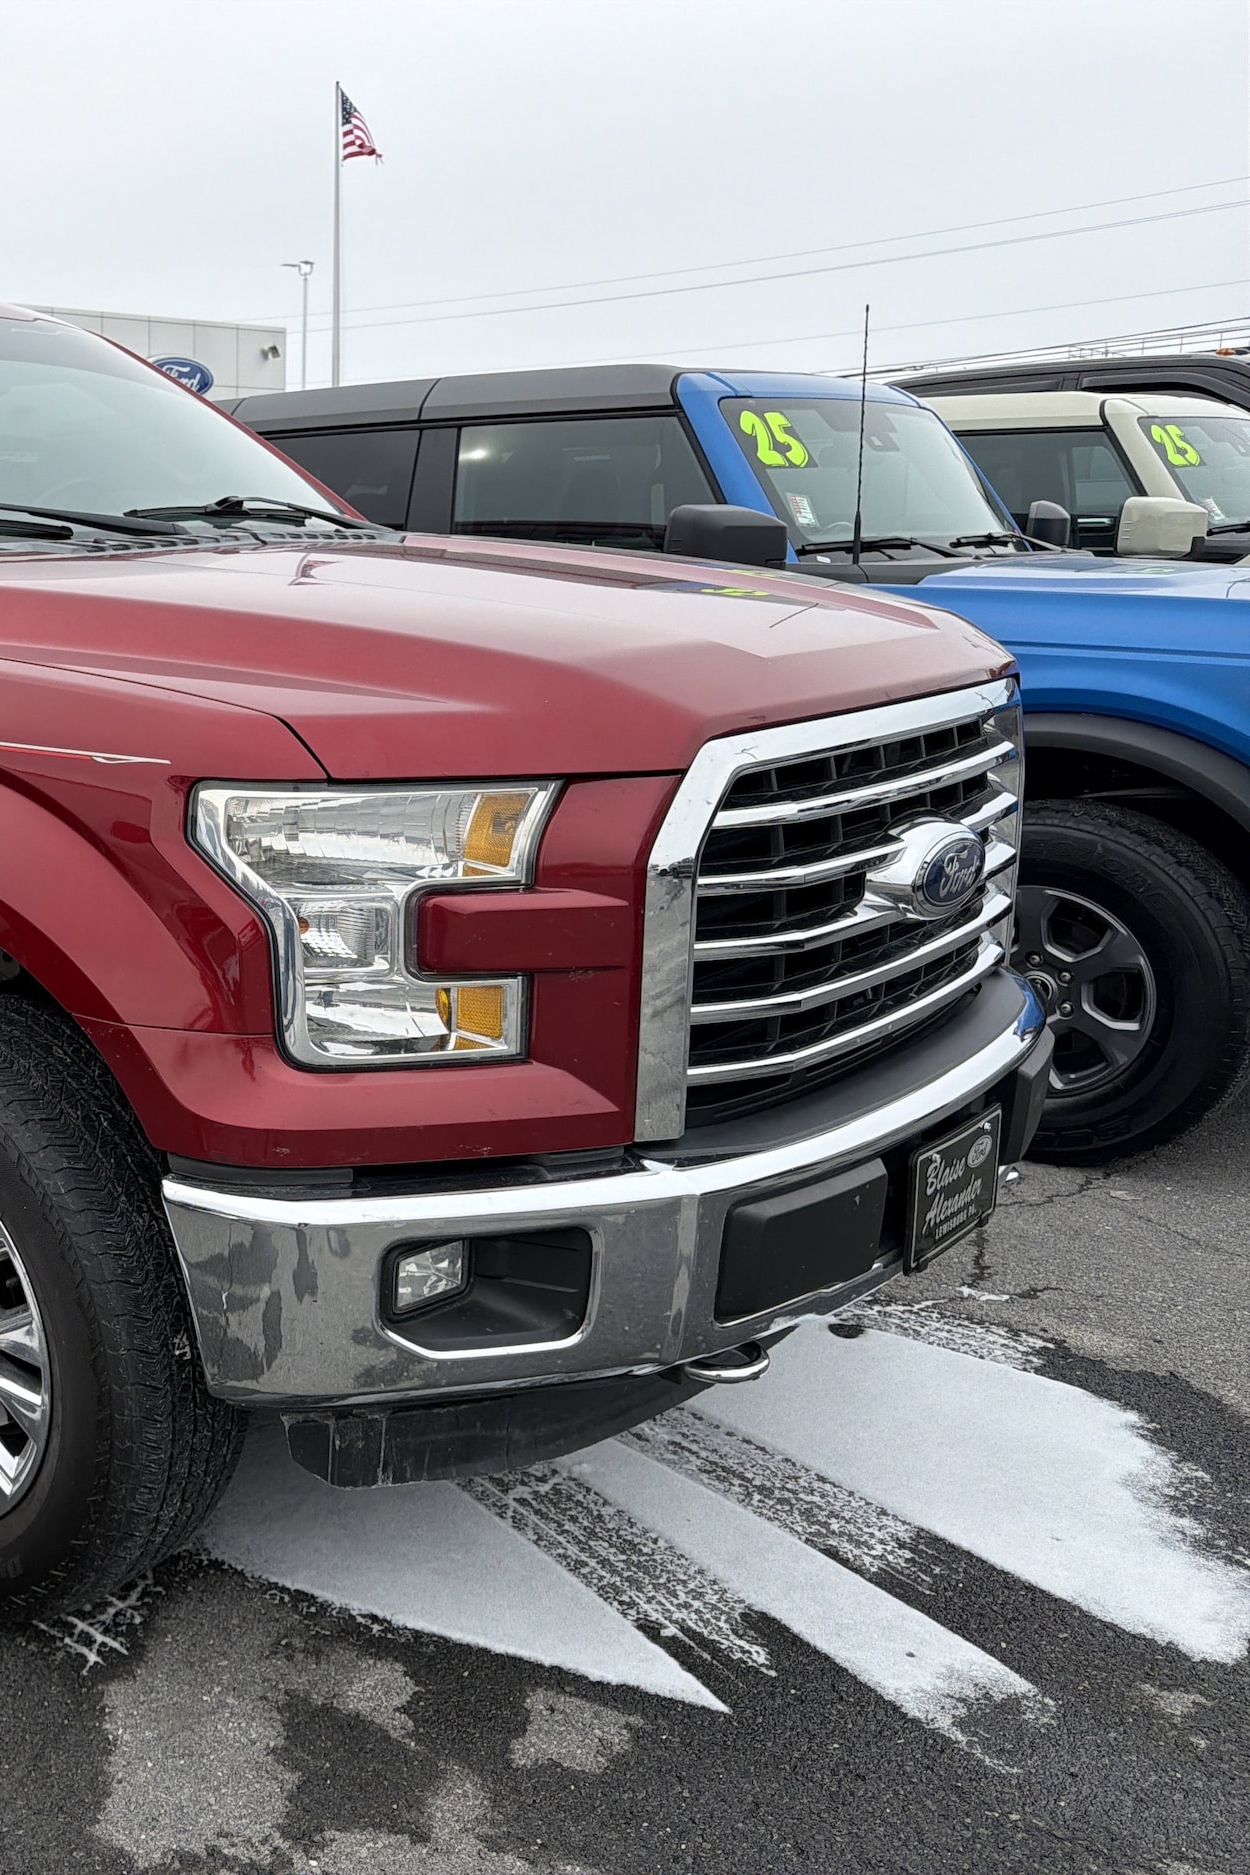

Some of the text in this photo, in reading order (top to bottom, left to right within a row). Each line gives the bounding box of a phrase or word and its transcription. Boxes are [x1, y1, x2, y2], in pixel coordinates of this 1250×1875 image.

[739, 410, 809, 467] 25
[1151, 424, 1200, 466] 25
[939, 849, 980, 898] Ford
[926, 1157, 966, 1196] Blaise
[922, 1173, 982, 1234] Alexander
